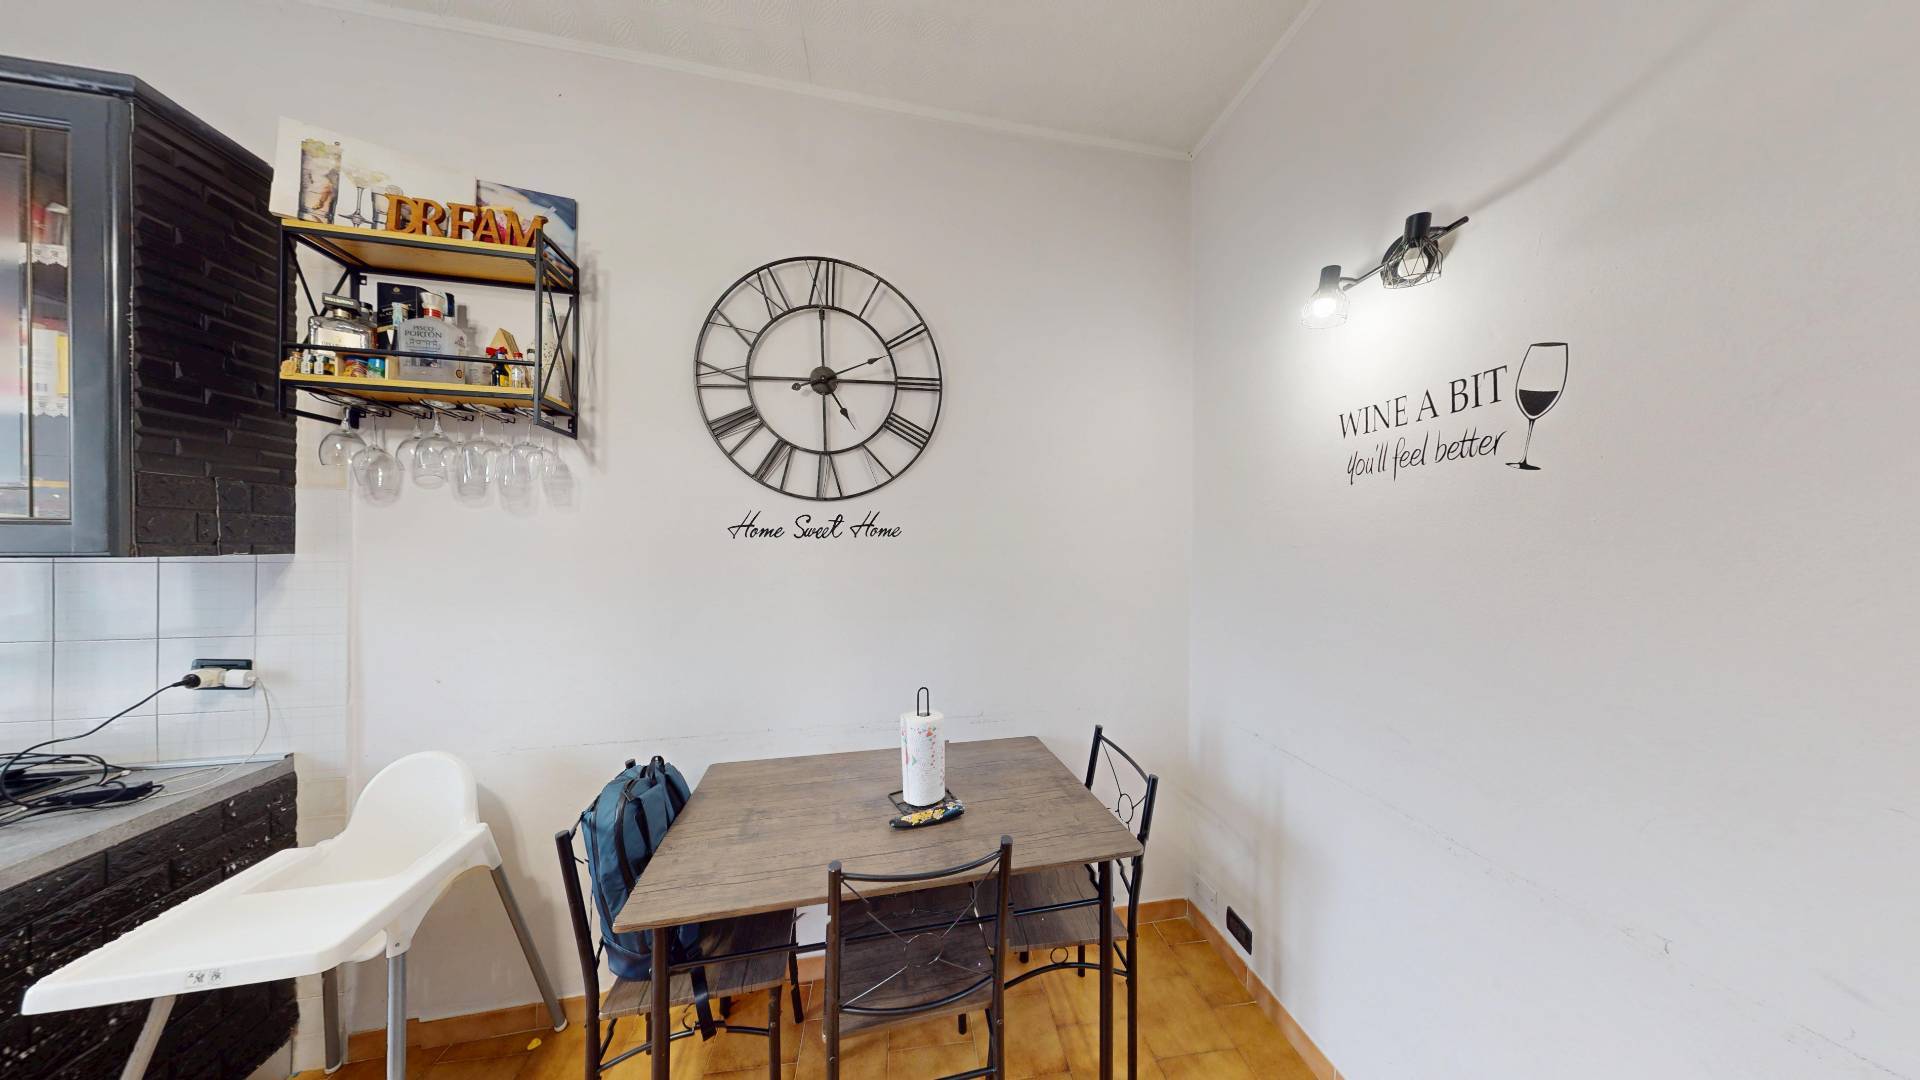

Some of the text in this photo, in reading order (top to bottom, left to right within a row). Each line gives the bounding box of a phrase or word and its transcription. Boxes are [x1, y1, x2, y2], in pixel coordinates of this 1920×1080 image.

[1339, 365, 1508, 439] WINE A BIT
[1347, 426, 1508, 485] you'll feel better
[727, 510, 902, 539] Home Sweet Home
